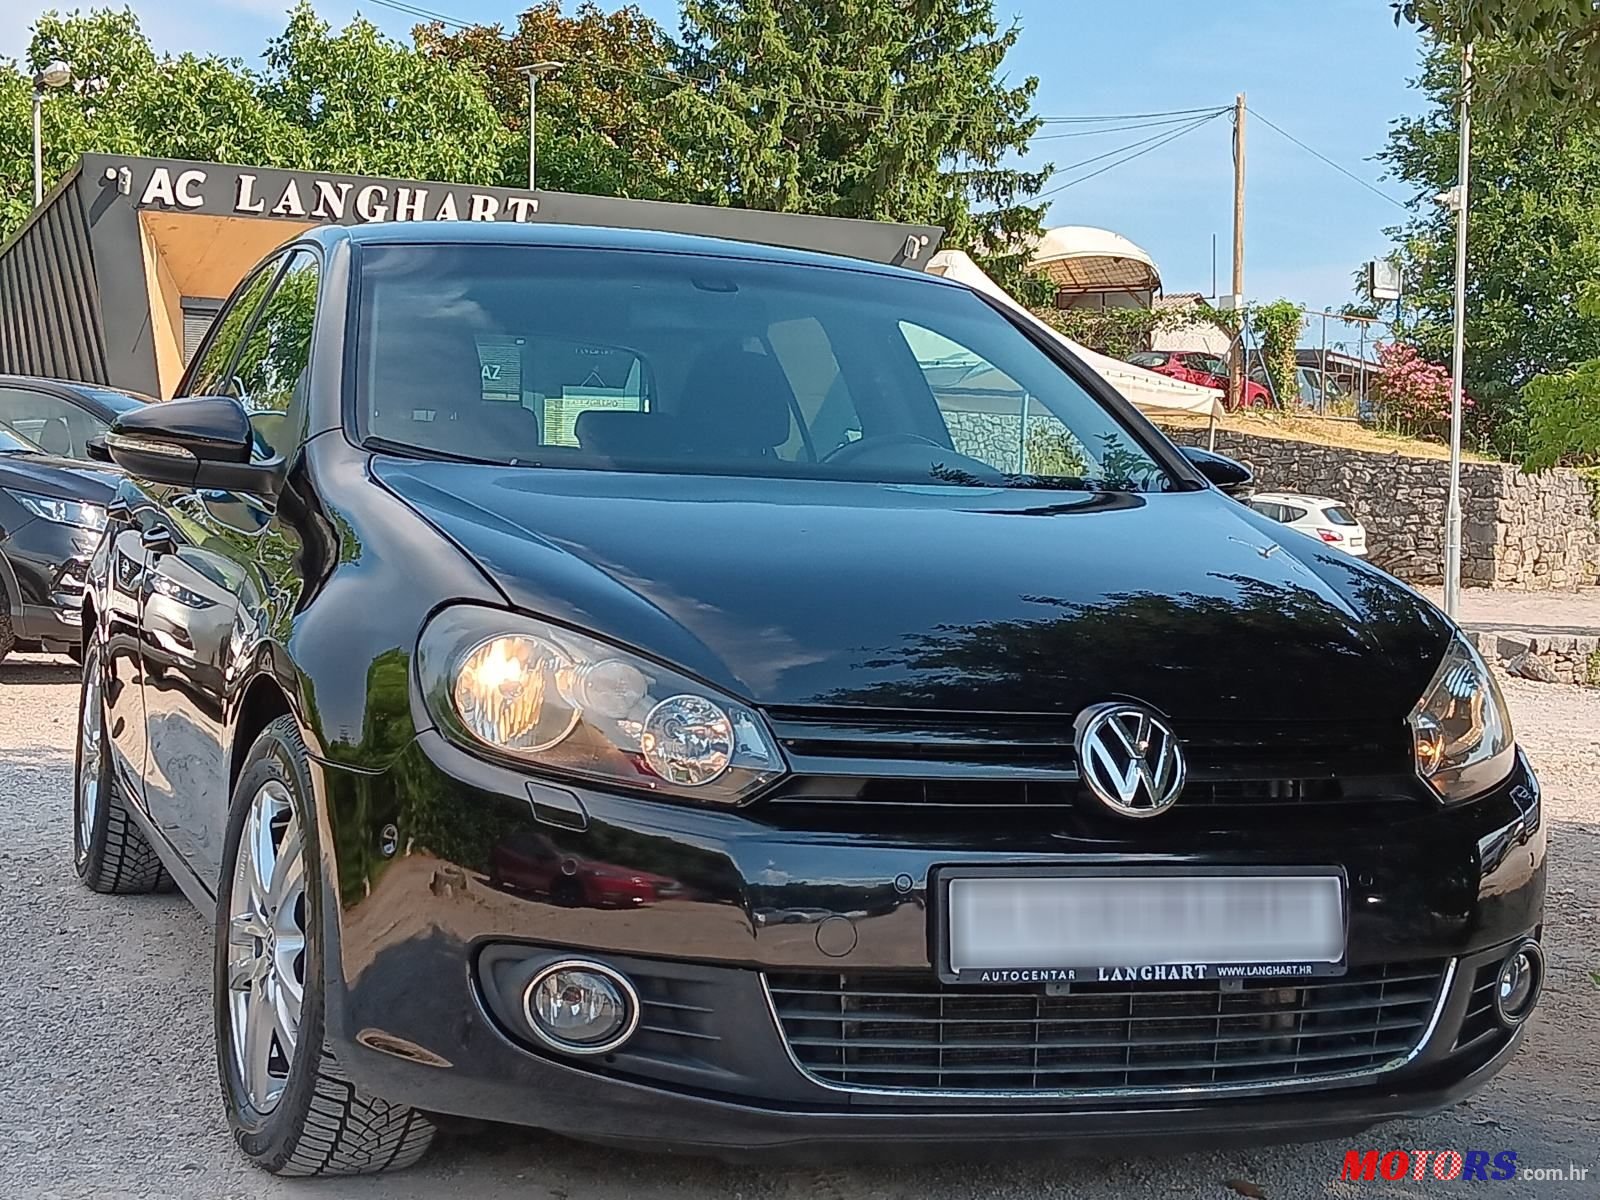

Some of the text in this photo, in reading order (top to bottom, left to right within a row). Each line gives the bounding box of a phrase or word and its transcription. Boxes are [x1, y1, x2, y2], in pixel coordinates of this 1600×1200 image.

[141, 167, 539, 223] AC LANGHART
[1082, 705, 1184, 815] VW
[981, 965, 1313, 982] AUTOCENTAR LANGHART WWW.LANGHART.HR
